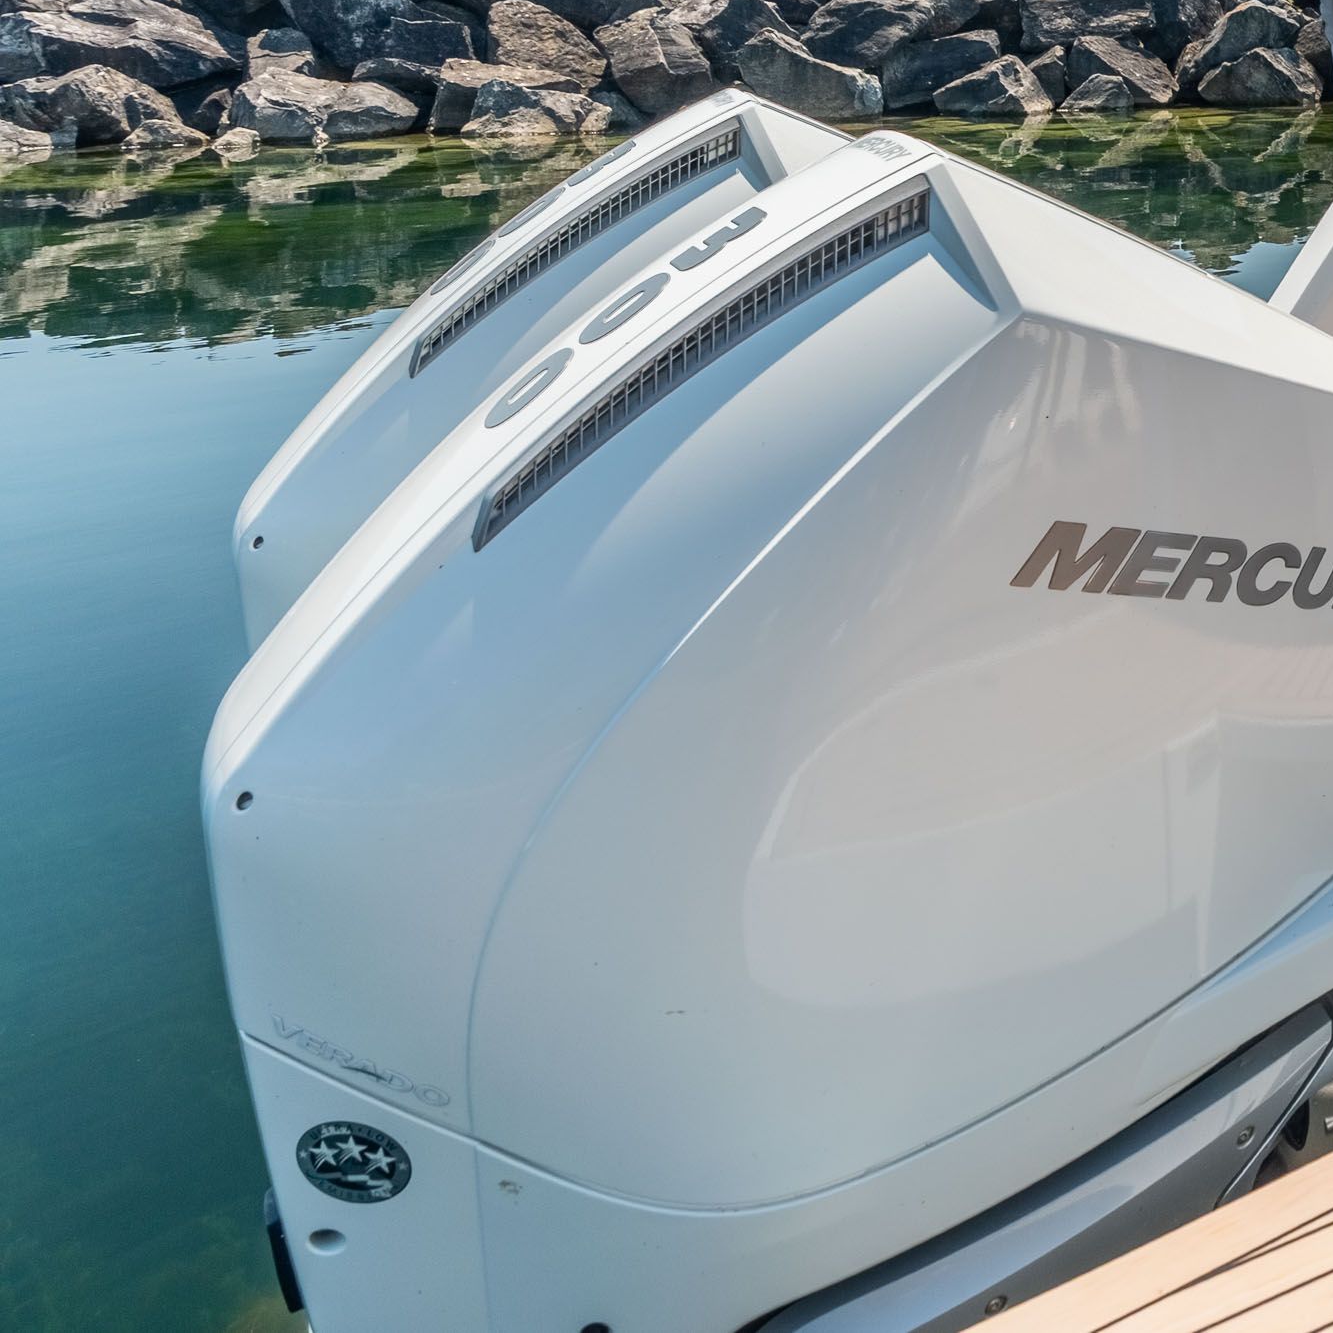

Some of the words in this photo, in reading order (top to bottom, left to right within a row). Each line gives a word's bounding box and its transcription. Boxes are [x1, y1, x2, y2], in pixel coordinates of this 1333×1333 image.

[484, 206, 768, 428] 300
[270, 1013, 451, 1108] VERADO
[366, 1129, 398, 1151] LOW
